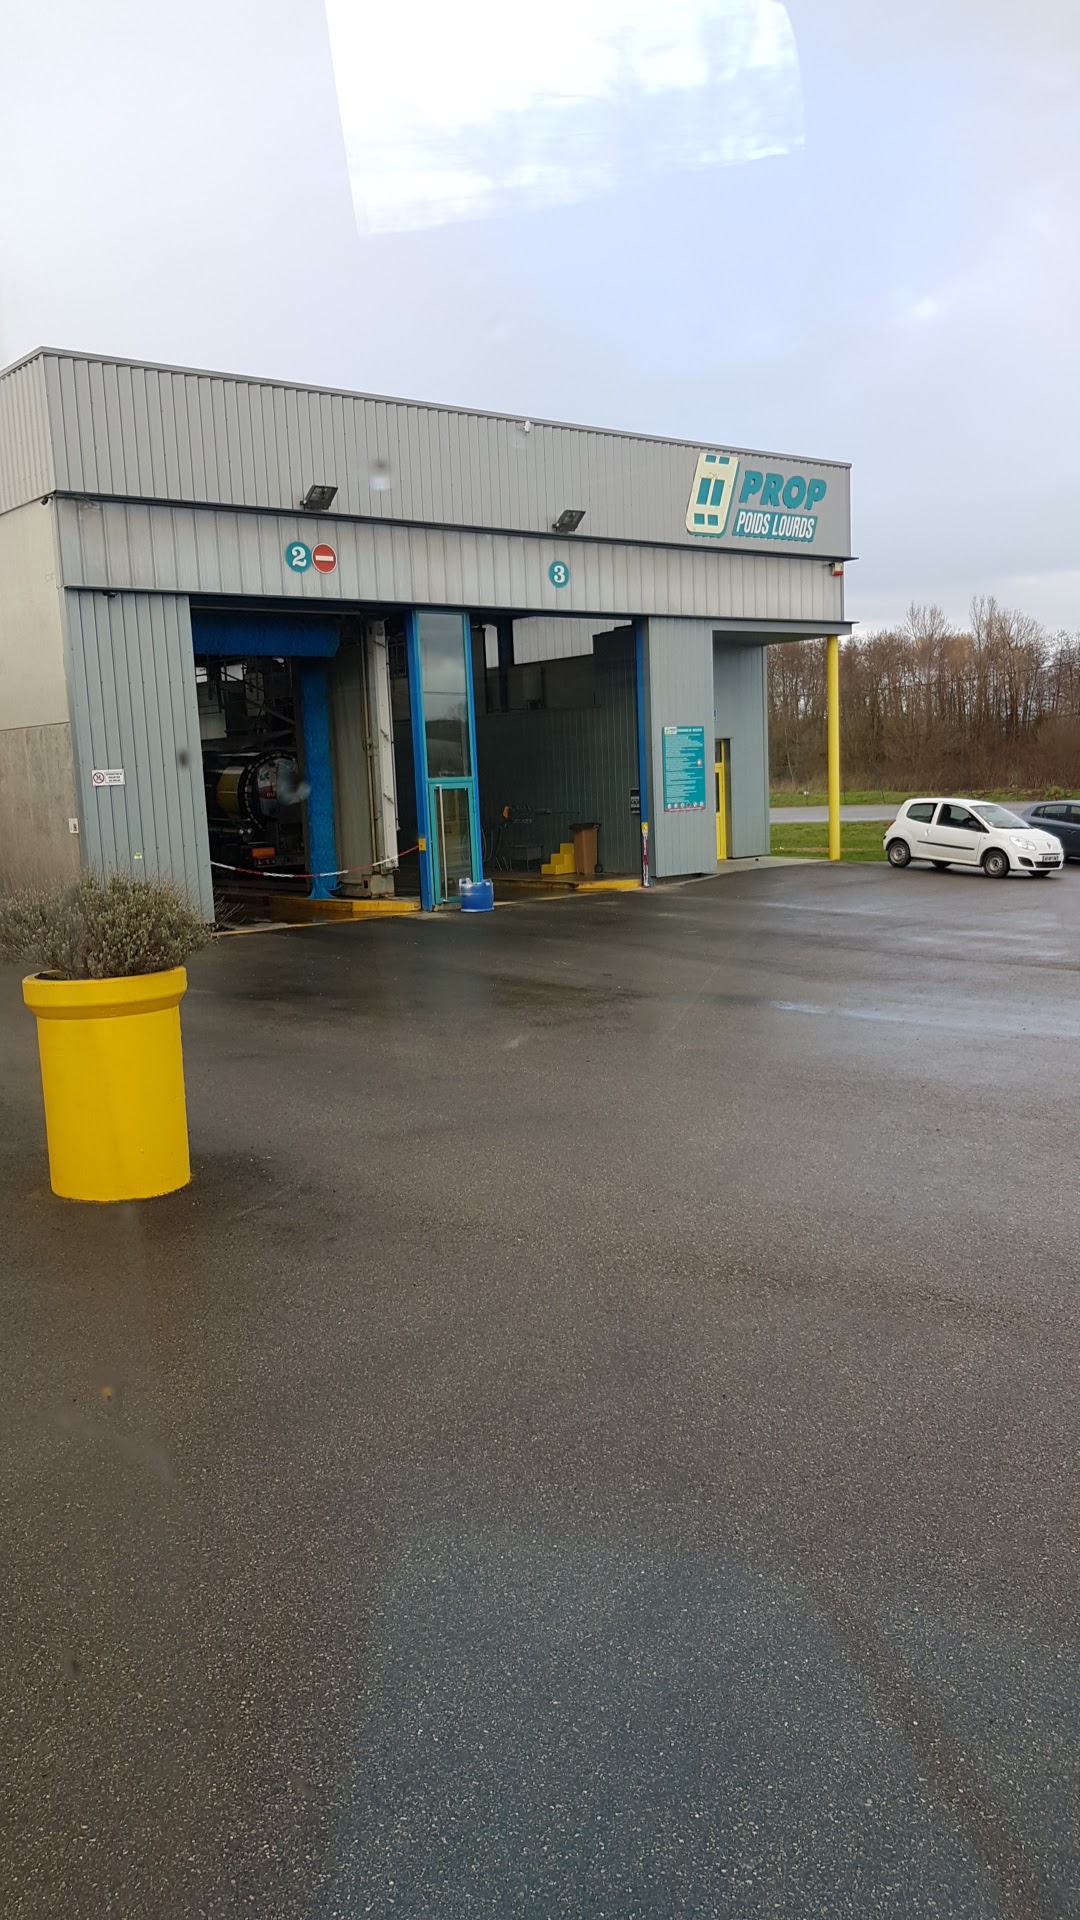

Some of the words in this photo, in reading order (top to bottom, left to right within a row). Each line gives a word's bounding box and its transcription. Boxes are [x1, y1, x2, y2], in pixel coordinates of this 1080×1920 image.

[738, 470, 827, 511] PROP
[736, 511, 770, 534] POIDS
[773, 516, 814, 538] LOURDS
[291, 546, 307, 567] 2
[553, 565, 566, 583] 3
